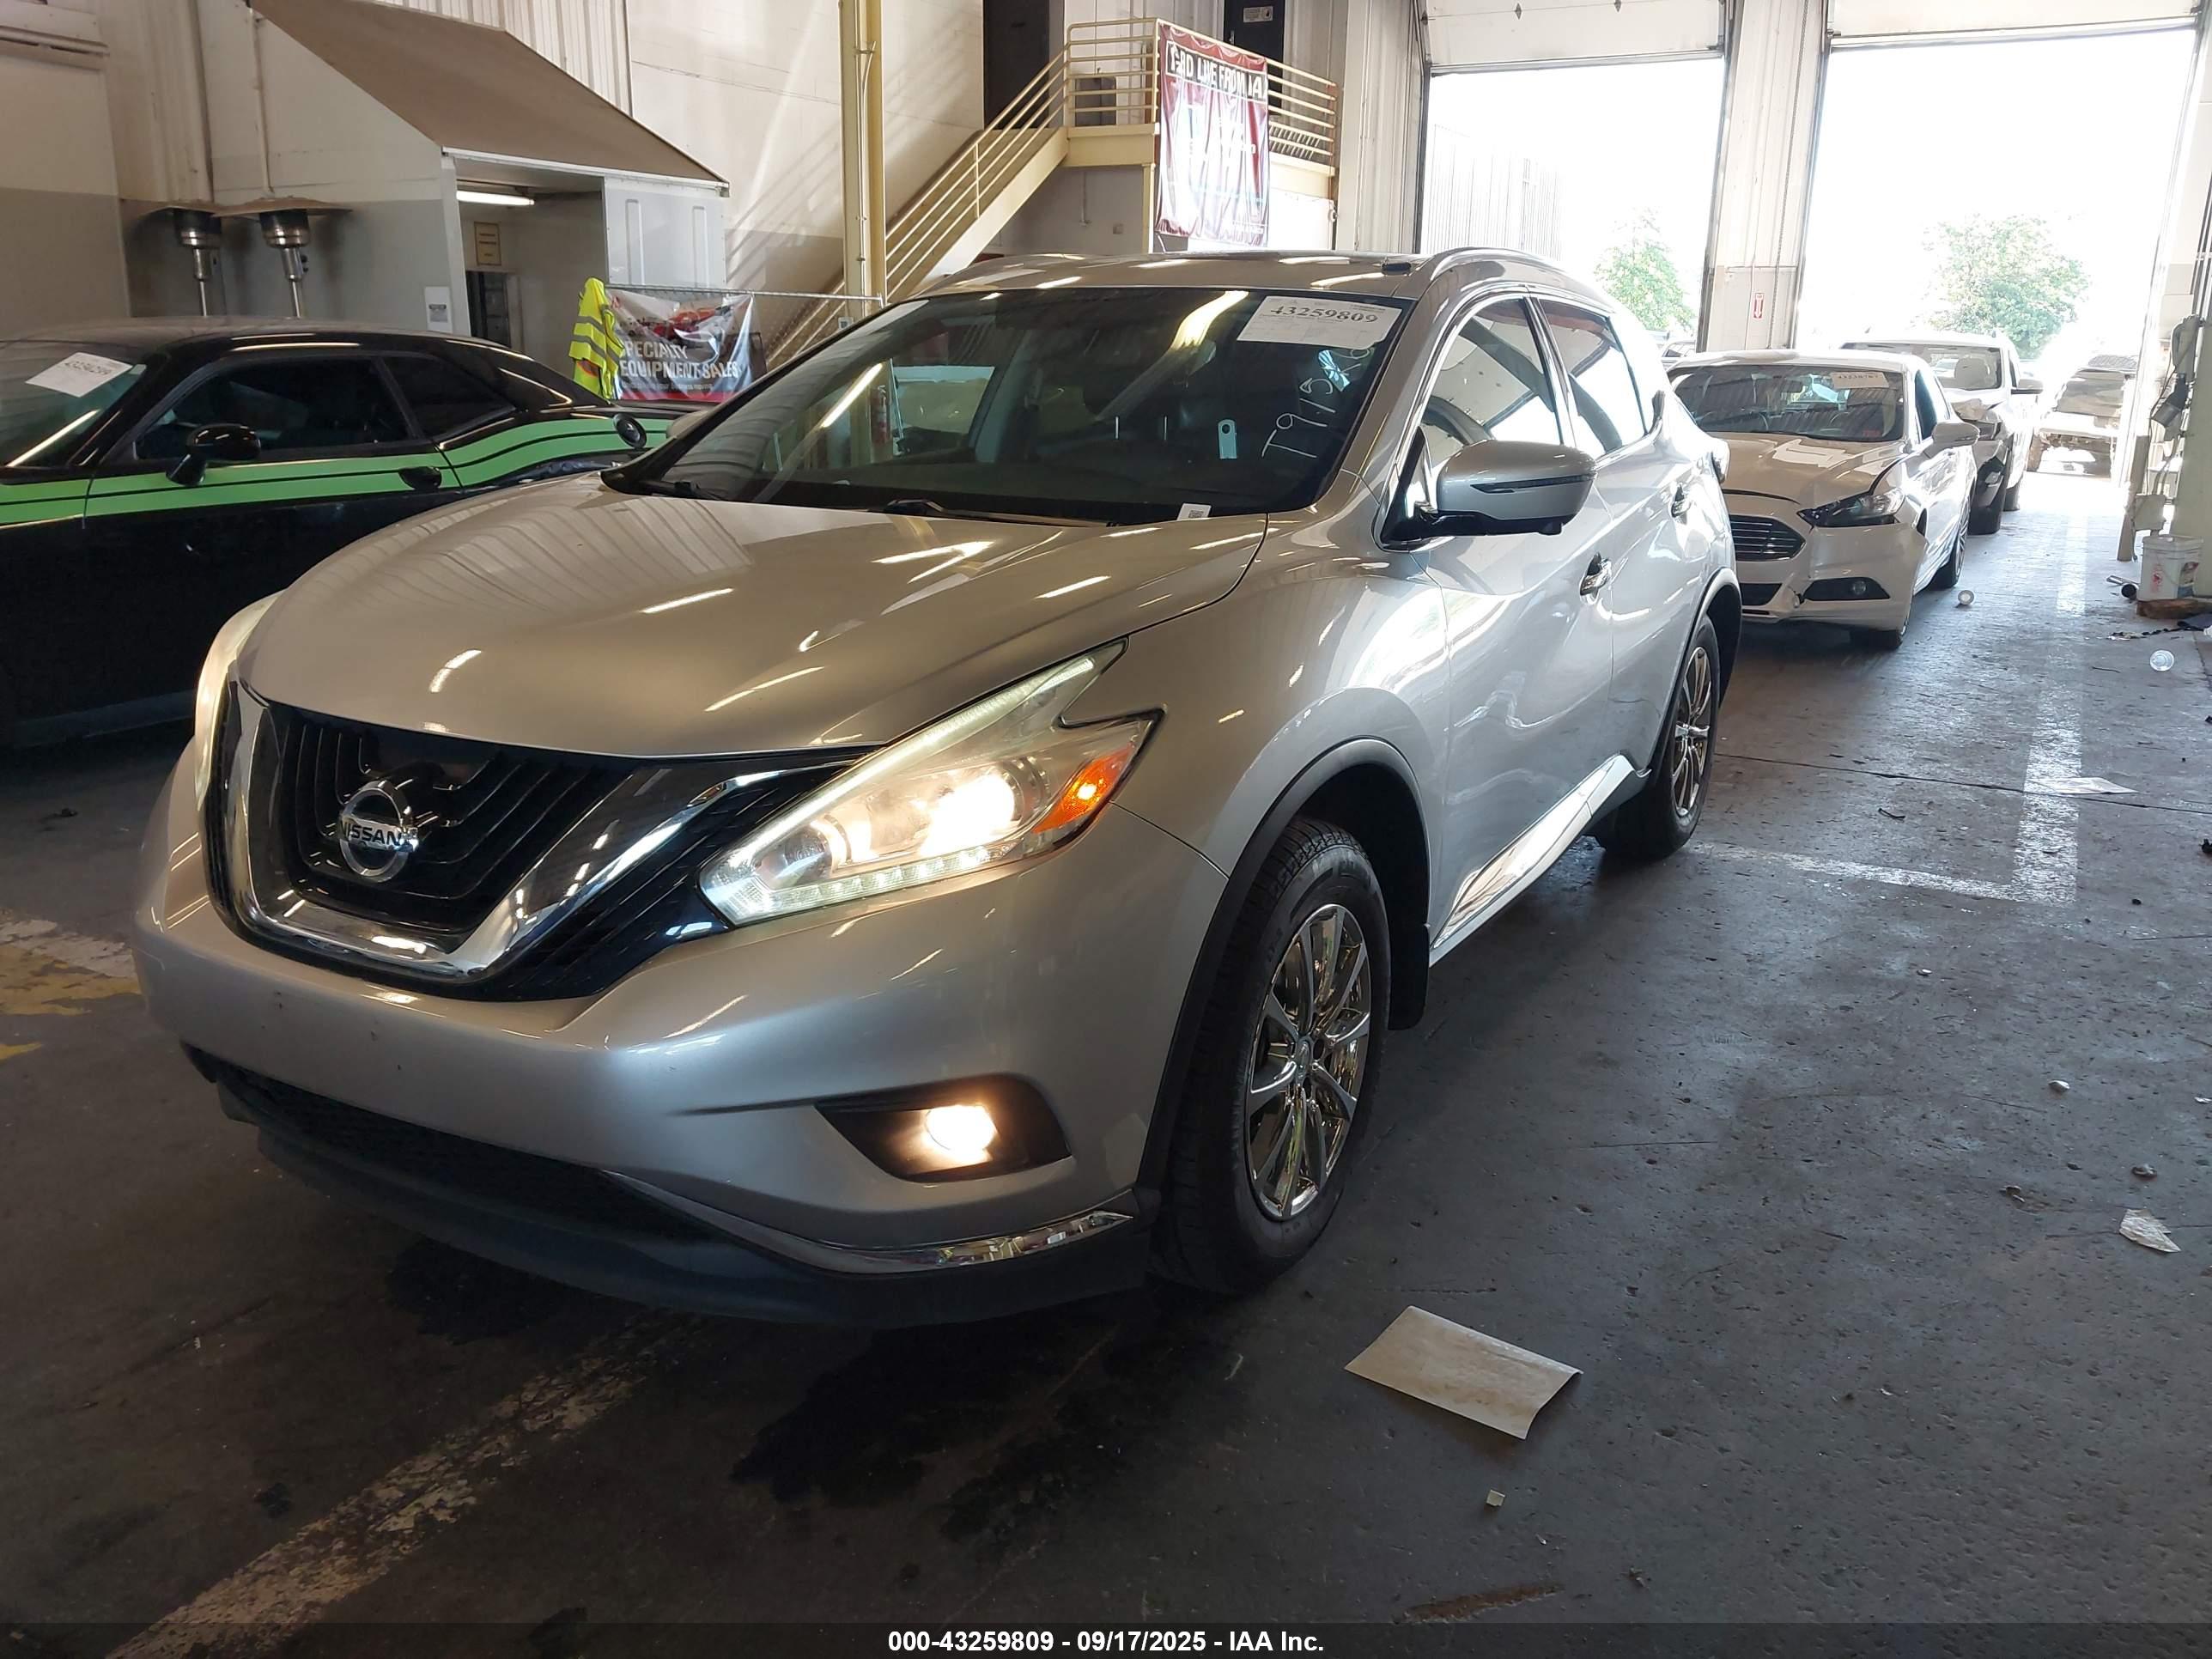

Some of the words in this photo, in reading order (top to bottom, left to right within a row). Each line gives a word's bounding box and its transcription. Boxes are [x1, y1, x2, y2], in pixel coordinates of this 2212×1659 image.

[1218, 64, 1246, 97] FROM
[1271, 305, 1378, 323] 43259809
[624, 339, 688, 359] PECIALTY
[619, 360, 700, 379] EQUIPMENT
[702, 362, 739, 379] SALES
[344, 821, 402, 846] NISSAN
